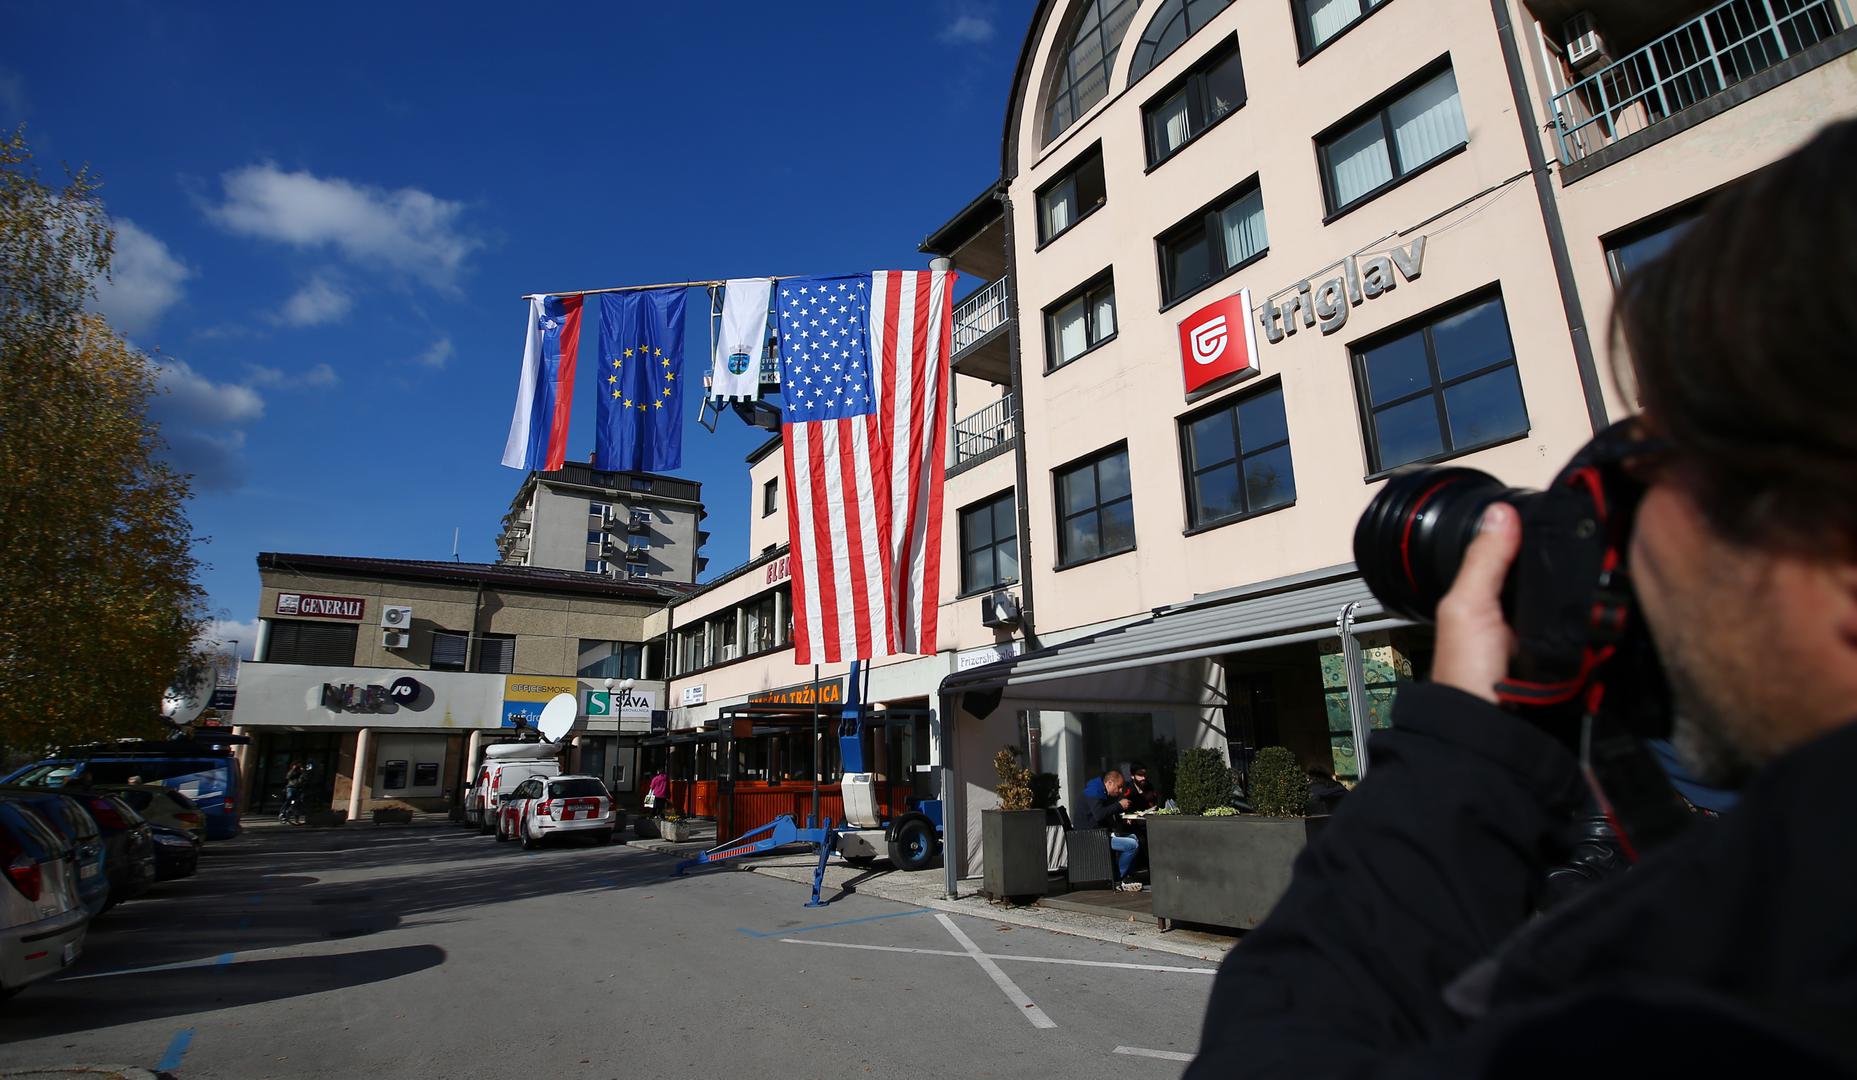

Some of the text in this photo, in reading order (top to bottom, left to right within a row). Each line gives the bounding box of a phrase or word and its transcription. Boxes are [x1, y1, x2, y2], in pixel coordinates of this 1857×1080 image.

[1259, 235, 1427, 344] triglav
[301, 598, 360, 616] GENERALI
[615, 696, 649, 708] SAVA
